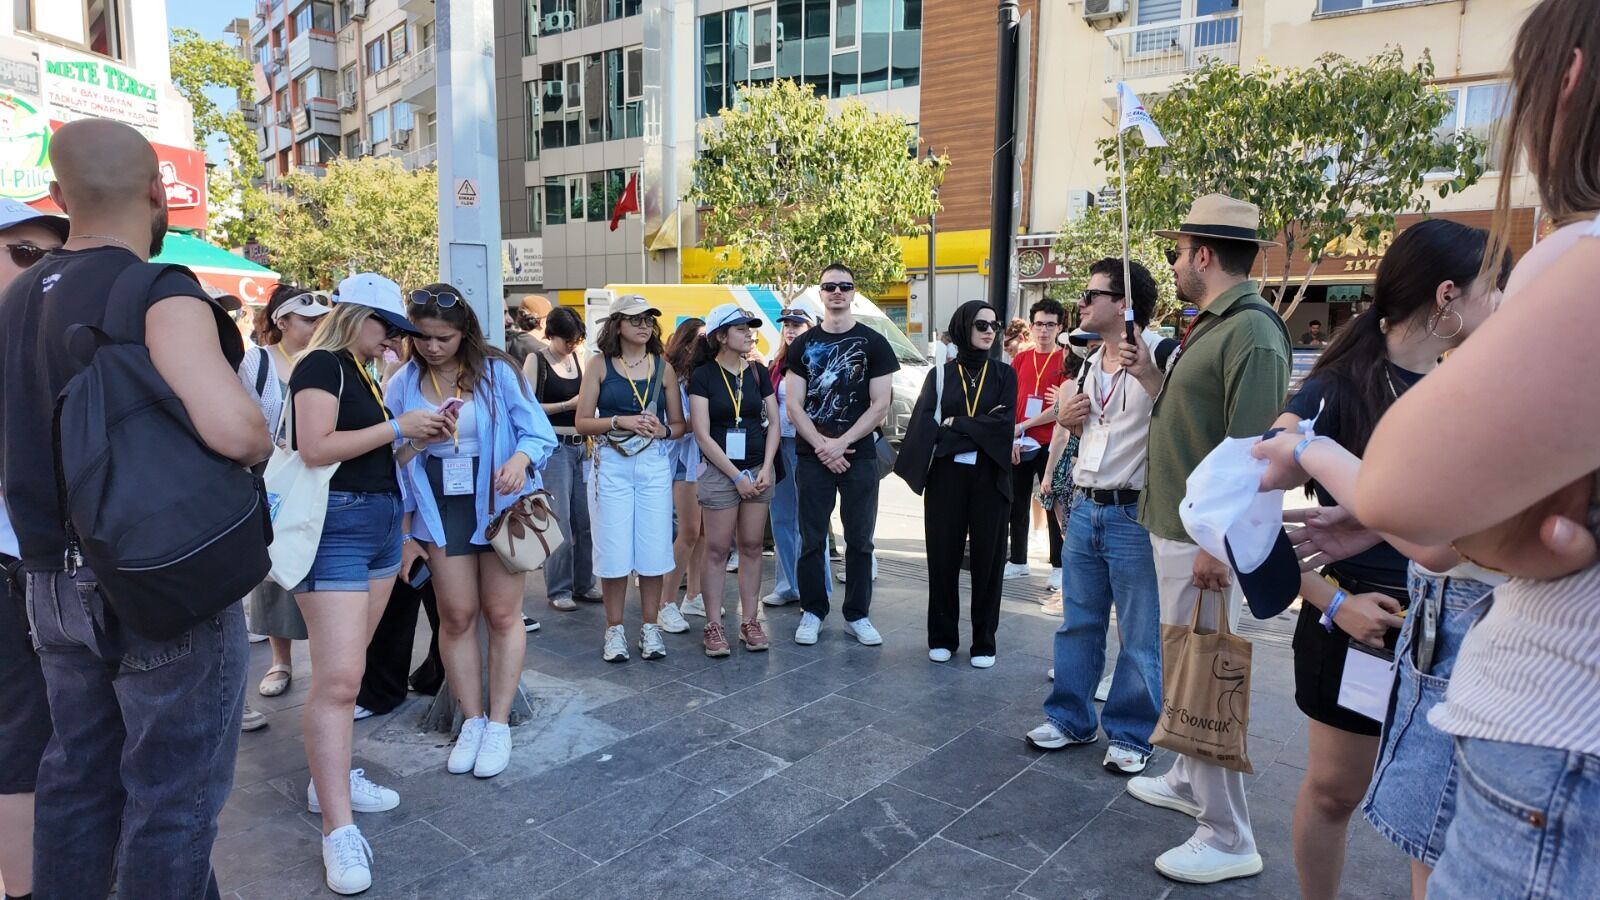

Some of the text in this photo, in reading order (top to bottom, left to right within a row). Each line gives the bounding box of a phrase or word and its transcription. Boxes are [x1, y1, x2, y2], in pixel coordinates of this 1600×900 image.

[46, 60, 100, 86] METE
[103, 64, 157, 101] TERZİ
[81, 89, 133, 107] BAY BAYAN
[91, 102, 125, 116] ONARIM
